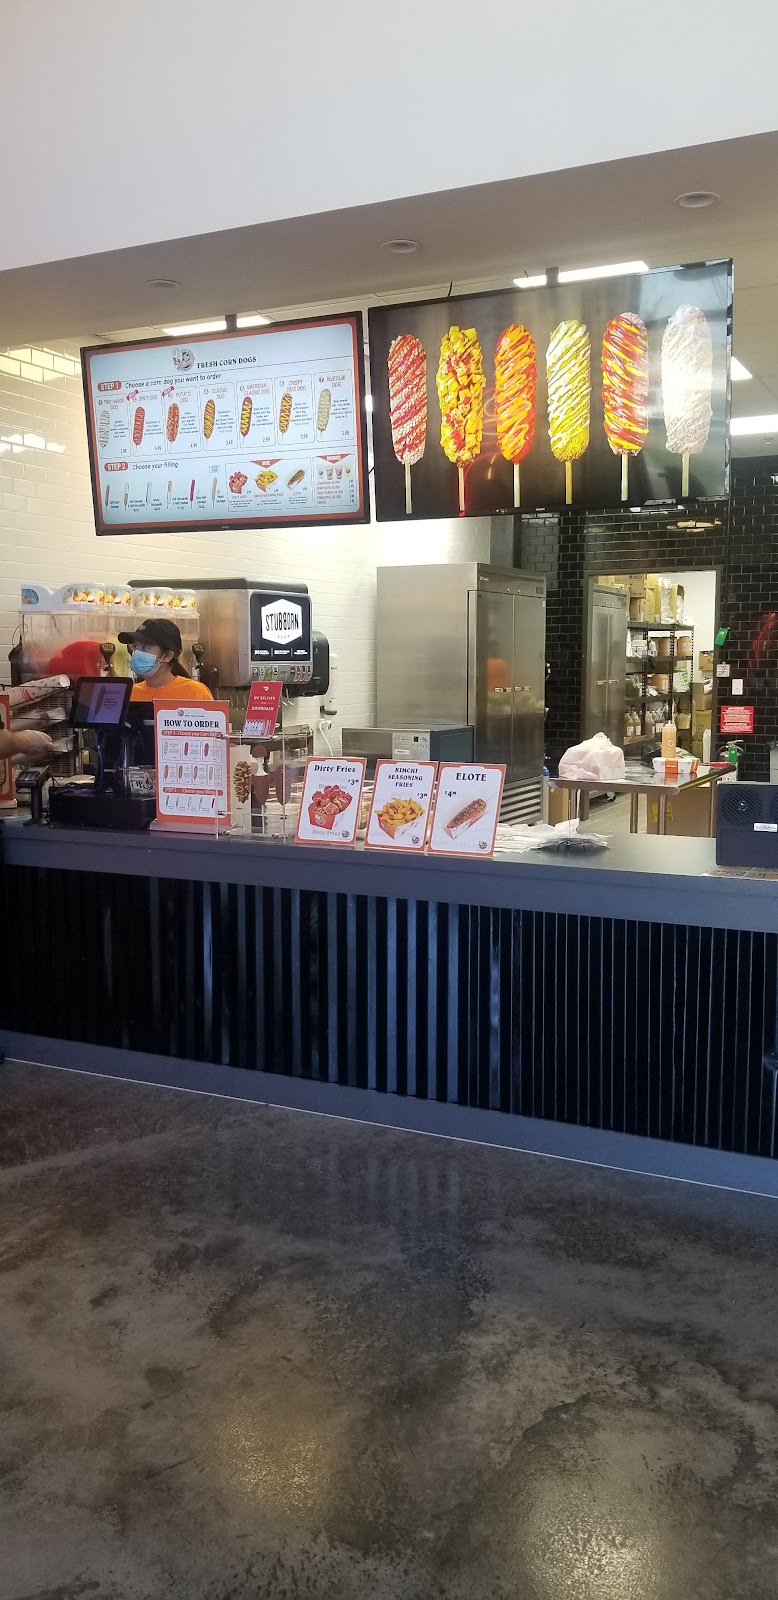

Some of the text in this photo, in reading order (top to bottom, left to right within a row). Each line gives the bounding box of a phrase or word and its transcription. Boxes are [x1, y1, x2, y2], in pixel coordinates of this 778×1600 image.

[196, 356, 257, 369] FRESH CORN DOGS
[101, 382, 114, 390] STEP
[125, 381, 145, 389] Choose
[174, 377, 185, 385] you
[107, 463, 121, 471] STEP
[265, 612, 299, 631] STUBBORN
[163, 719, 220, 728] HOW TO ORDER
[314, 764, 356, 773] Dirty Fries
[456, 772, 487, 782] ELOTE
